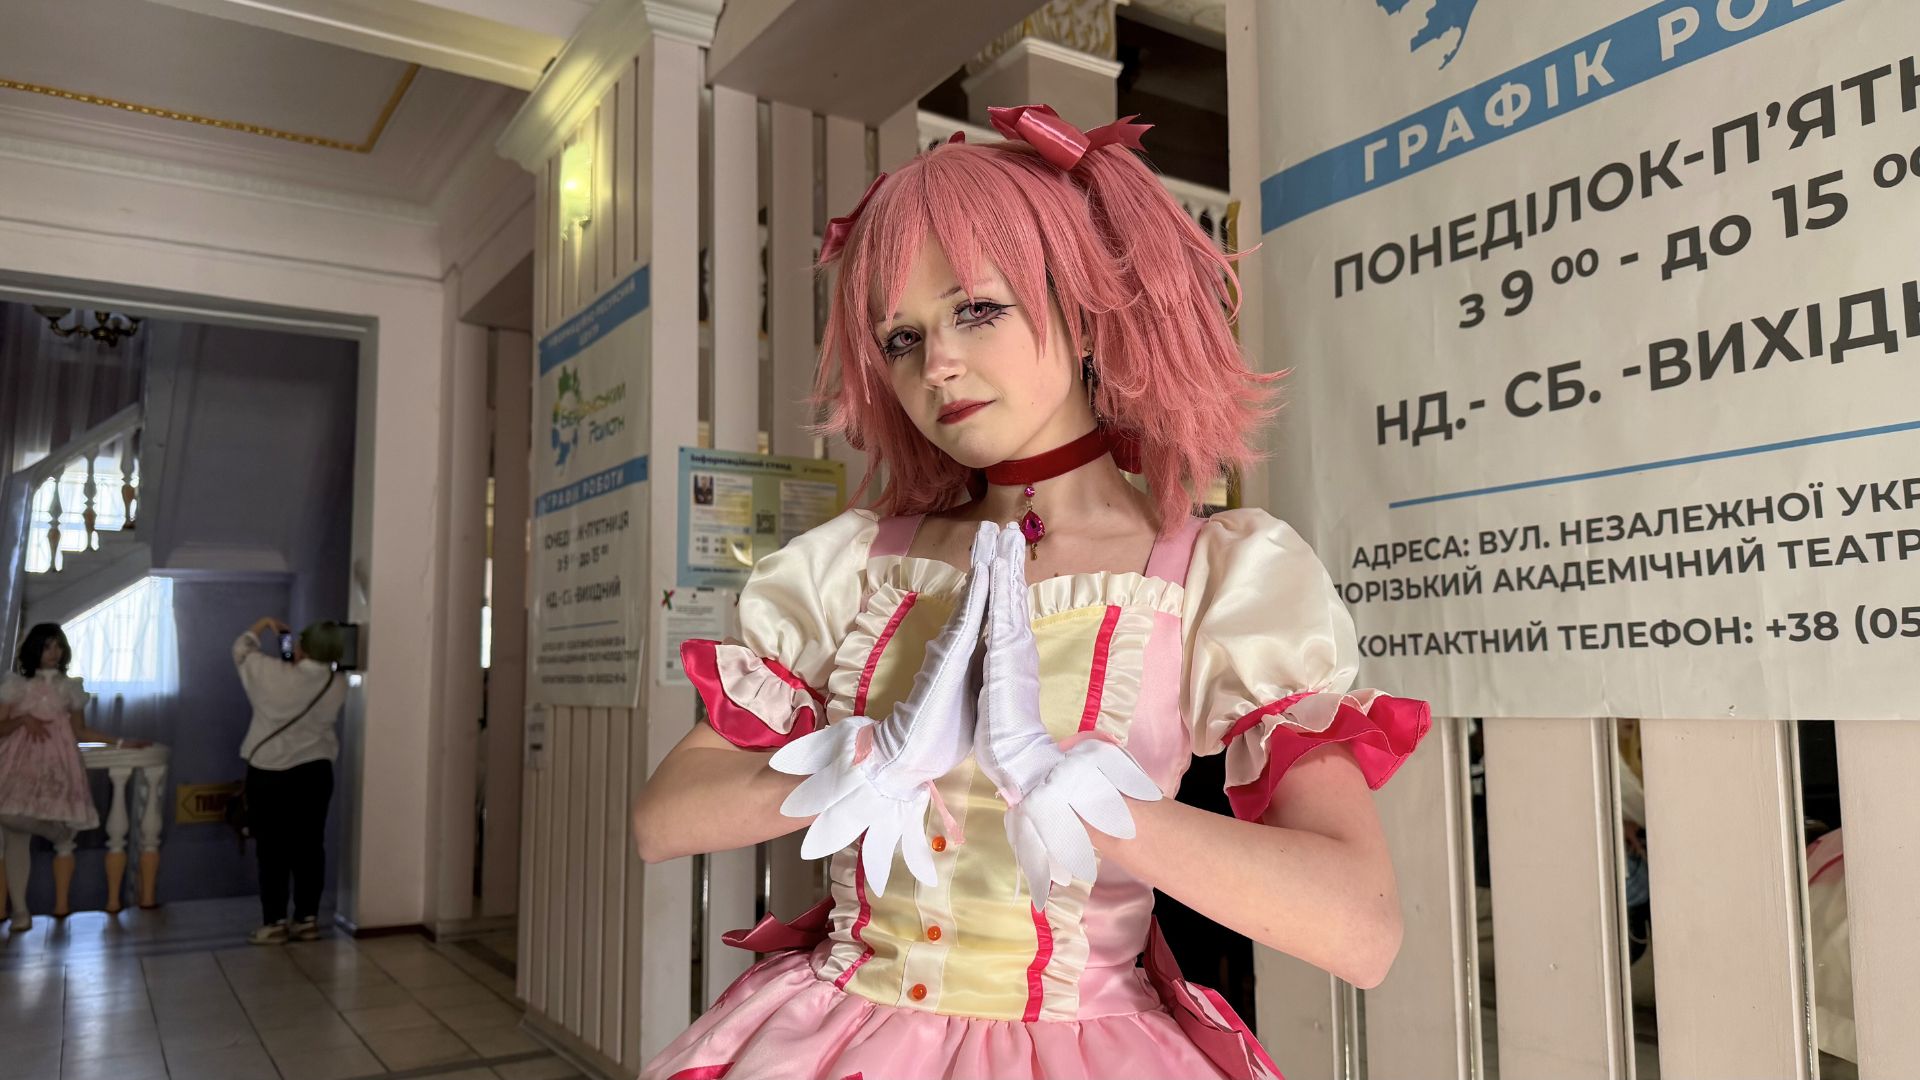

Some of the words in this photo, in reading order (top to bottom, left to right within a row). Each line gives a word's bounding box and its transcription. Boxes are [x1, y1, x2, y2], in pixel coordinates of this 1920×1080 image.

[1363, 40, 1615, 183] ГРАФІК
[1658, 0, 1818, 61] РО
[1459, 293, 1485, 329] з
[1502, 270, 1534, 317] 9
[1550, 249, 1599, 285] 00
[1621, 253, 1639, 266] -
[1661, 214, 1752, 280] до
[1772, 169, 1849, 239] 15
[1504, 360, 1602, 418] СБ.
[1352, 535, 1470, 571] АДРЕСА:
[1479, 525, 1549, 556] ВУЛ.
[1560, 481, 1823, 547] НЕЗАЛЕЖНОЇ
[1492, 536, 1765, 593] АКАДЕМІЧНИЙ
[1778, 528, 1920, 569] ТЕАТР
[1557, 616, 1754, 651] ТЕЛЕФОН:
[1766, 610, 1840, 642] +38
[1855, 604, 1920, 645] (05
